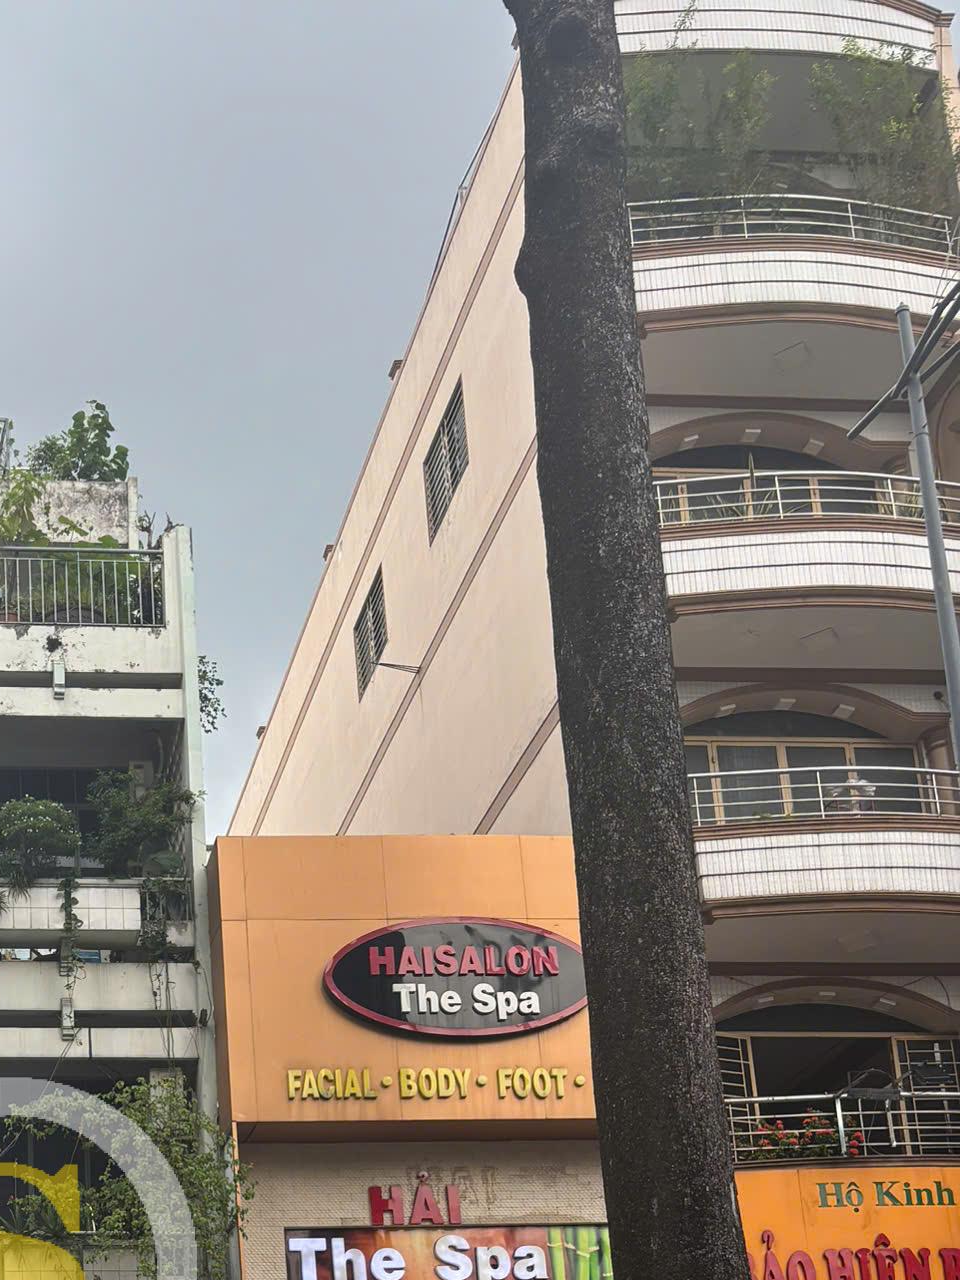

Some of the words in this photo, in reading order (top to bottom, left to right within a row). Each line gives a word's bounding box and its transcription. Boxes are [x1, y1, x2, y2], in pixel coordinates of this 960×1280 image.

[368, 944, 559, 977] HAISALON
[392, 983, 463, 1014] The
[472, 983, 541, 1020] Spa
[287, 1068, 377, 1099] FACIAL
[398, 1068, 471, 1098] BODY
[497, 1067, 569, 1098] FOOT
[368, 1171, 462, 1226] HẢI
[815, 1181, 864, 1213] Hộ
[872, 1180, 957, 1207] Kinh
